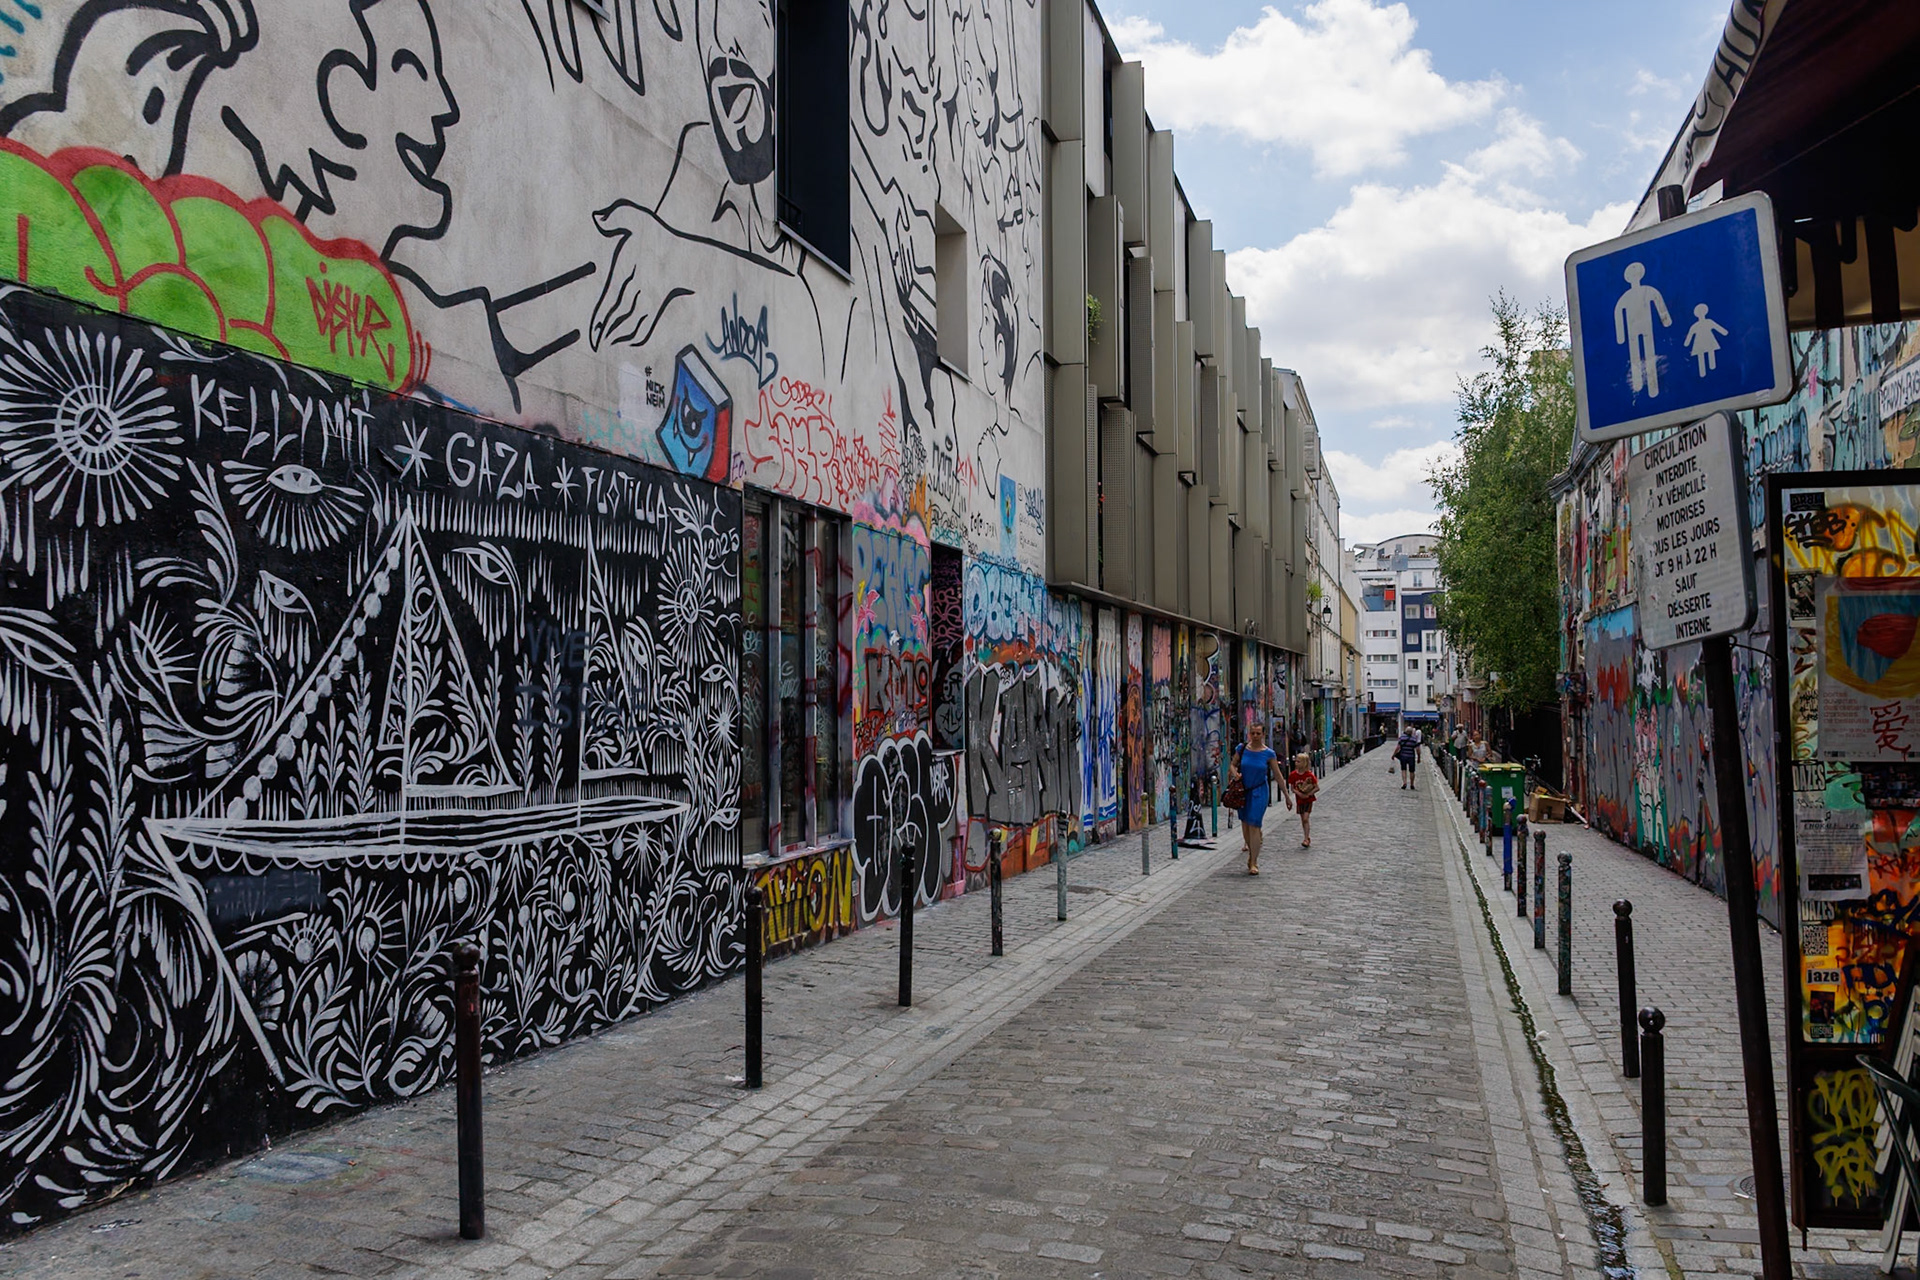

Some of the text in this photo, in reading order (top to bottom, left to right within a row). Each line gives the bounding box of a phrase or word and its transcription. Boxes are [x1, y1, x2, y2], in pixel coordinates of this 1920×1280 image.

[1644, 423, 1707, 470] CIRCULATION
[446, 432, 542, 503] GAZA
[1656, 455, 1698, 488] INTERDITE
[1657, 499, 1705, 532] MOTORISES
[708, 528, 739, 560] 2025
[1671, 530, 1688, 550] LES
[1691, 517, 1720, 542] JOURS
[1668, 558, 1674, 573] 9
[1676, 555, 1683, 571] H
[1694, 546, 1708, 565] 22
[1709, 542, 1717, 559] H
[1667, 592, 1712, 619] DESSERTE
[1675, 616, 1712, 640] INTERNE
[1792, 764, 1826, 792] DAZES
[1808, 969, 1840, 984] jaze
